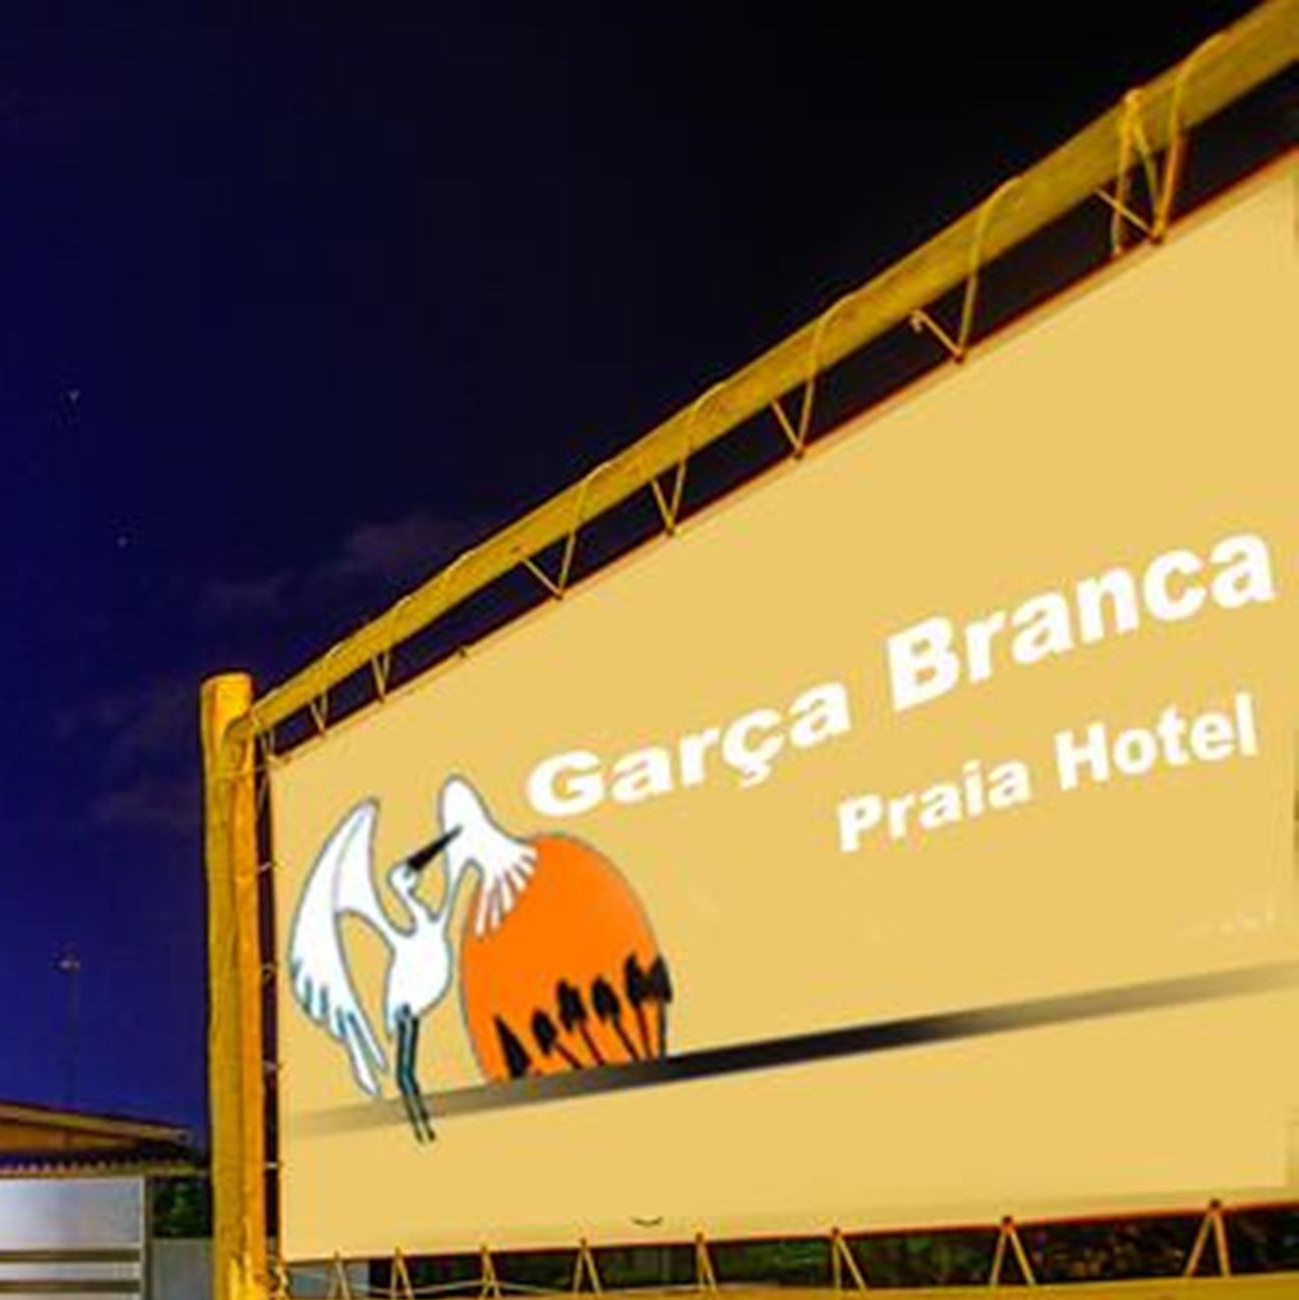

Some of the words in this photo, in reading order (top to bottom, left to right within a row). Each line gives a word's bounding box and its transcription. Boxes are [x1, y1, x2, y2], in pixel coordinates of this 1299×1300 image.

[527, 682, 851, 818] Garça
[887, 534, 1276, 714] Branca
[839, 760, 1031, 852] Praia
[1055, 692, 1257, 790] Hotel
